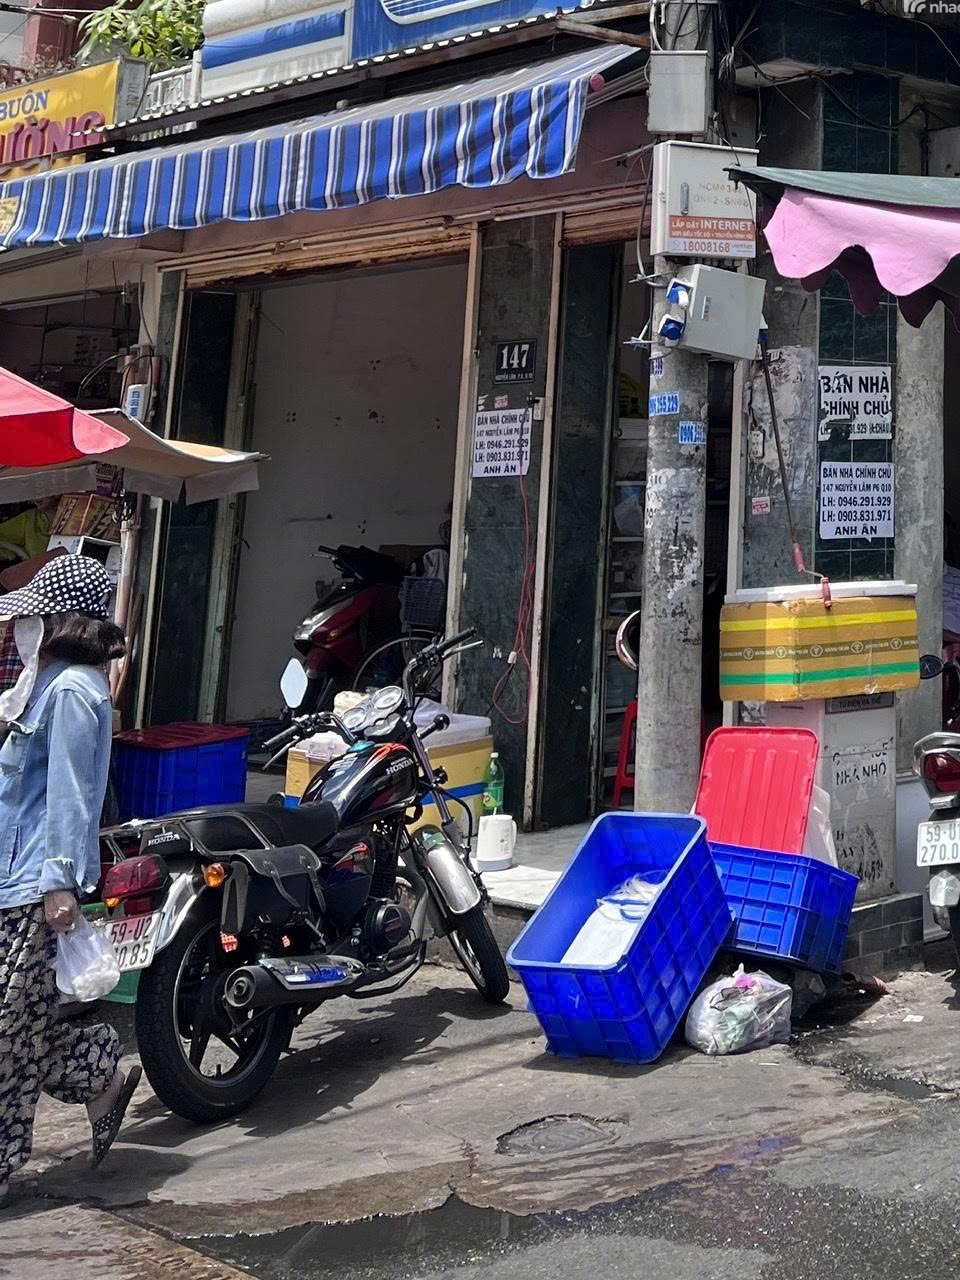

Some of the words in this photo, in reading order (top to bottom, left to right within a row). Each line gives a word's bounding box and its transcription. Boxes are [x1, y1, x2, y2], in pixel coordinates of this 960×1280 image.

[700, 219, 752, 231] INTERNET
[683, 241, 731, 253] 18008168
[501, 344, 530, 370] 147
[820, 370, 853, 394] BÁN
[858, 370, 890, 394] NHÀ
[863, 394, 889, 416] CHỦ
[477, 414, 488, 426] BÁN
[489, 413, 500, 425] NHÀ
[475, 440, 486, 450] LH:
[475, 452, 485, 463] LH:
[483, 465, 501, 474] ANH
[823, 465, 838, 478] BÁN
[839, 465, 853, 478] NHÀ
[855, 464, 877, 478] CHÍNH
[878, 464, 892, 479] CHỦ
[822, 483, 834, 492] 147
[834, 480, 857, 492] NGUYỄN
[858, 481, 871, 492] LÂM
[872, 483, 880, 492] P6
[880, 483, 892, 493] Q10
[822, 496, 836, 507] LH:
[837, 496, 892, 507] 0946.291.929
[822, 510, 836, 522] LH:
[837, 509, 891, 522] 0903.831.971
[834, 525, 857, 536] ANH
[861, 523, 878, 536] ÂN
[386, 758, 414, 775] HONDA
[147, 833, 180, 846] HONDA
[115, 939, 151, 969] 0.85
